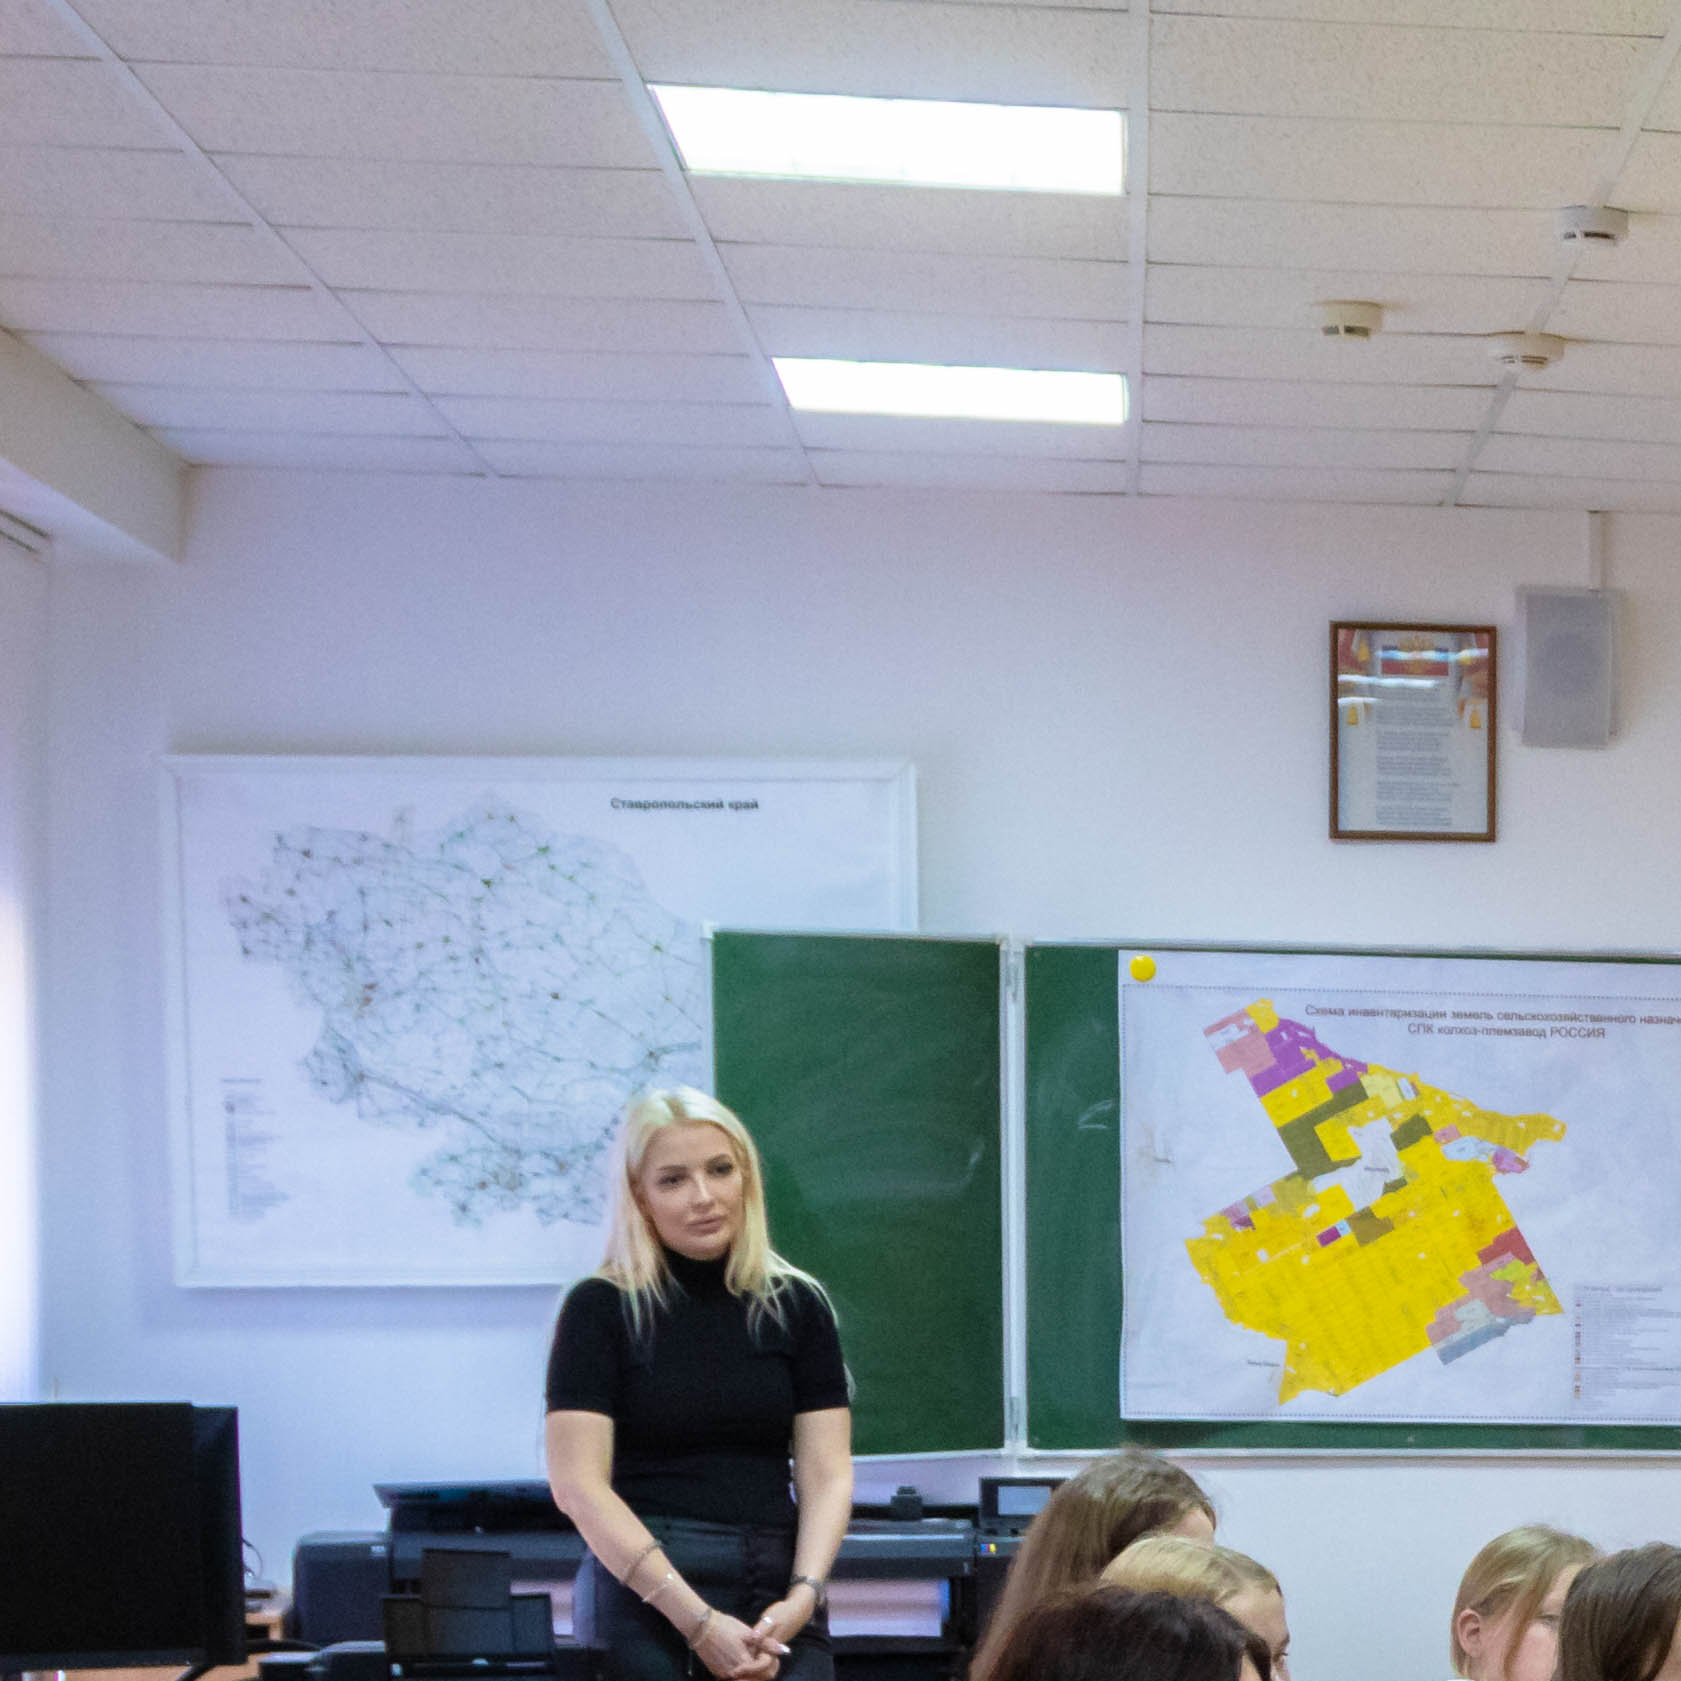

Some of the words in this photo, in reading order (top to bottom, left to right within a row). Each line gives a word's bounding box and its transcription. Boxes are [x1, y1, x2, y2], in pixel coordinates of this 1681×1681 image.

[610, 797, 724, 811] Ставропольский
[728, 798, 759, 811] край
[1304, 1004, 1345, 1016] Схема
[1348, 1005, 1447, 1020] инвентаризации
[1450, 1009, 1493, 1021] земель
[1496, 1010, 1636, 1025] сельскохозяйственного
[1407, 1022, 1435, 1035] СПК
[1437, 1025, 1547, 1040] колхоз-племзавод
[1550, 1026, 1606, 1039] РОССИЯ
